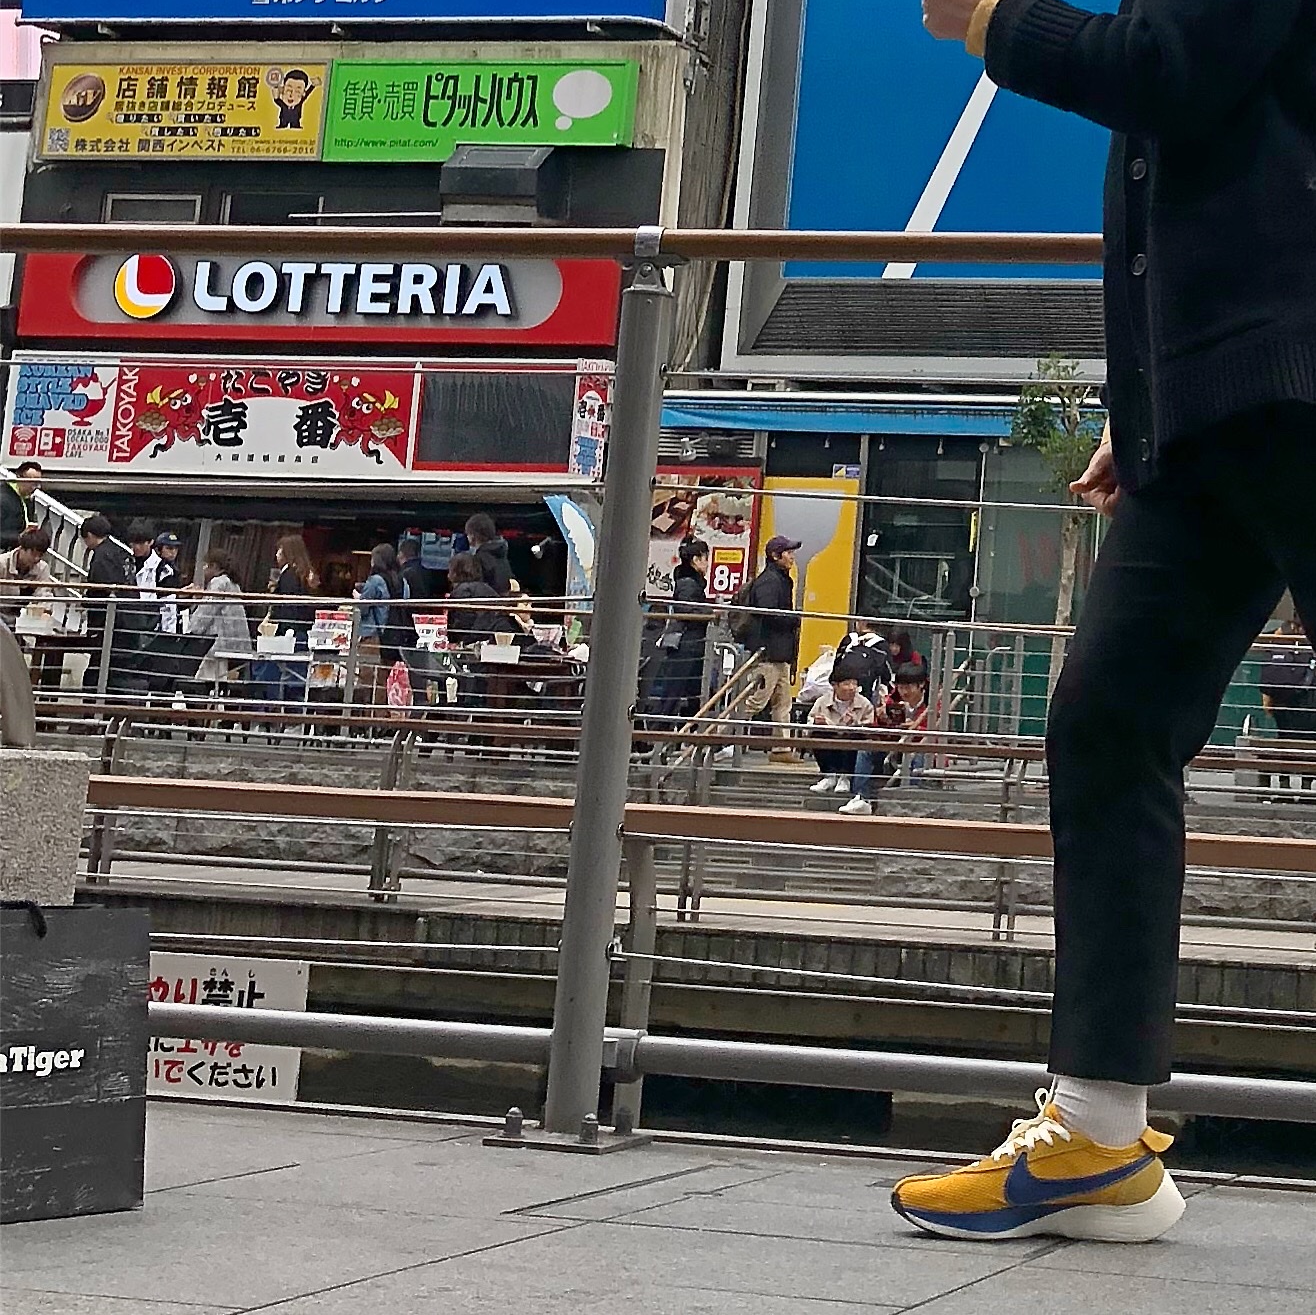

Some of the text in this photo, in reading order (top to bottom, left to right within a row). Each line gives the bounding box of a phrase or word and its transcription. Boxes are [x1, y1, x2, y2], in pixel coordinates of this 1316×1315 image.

[119, 67, 261, 76] KANSAI INVEST CORPORATION
[116, 76, 260, 100] 店舗情報館
[341, 71, 539, 128] 賃貸・売買 ピタットハウス
[75, 138, 225, 153] 株式会社 関西インベスト
[193, 260, 512, 316] LOTTERIA
[220, 370, 330, 396] たこやき
[13, 409, 45, 426] ICE
[713, 564, 741, 592] 8F
